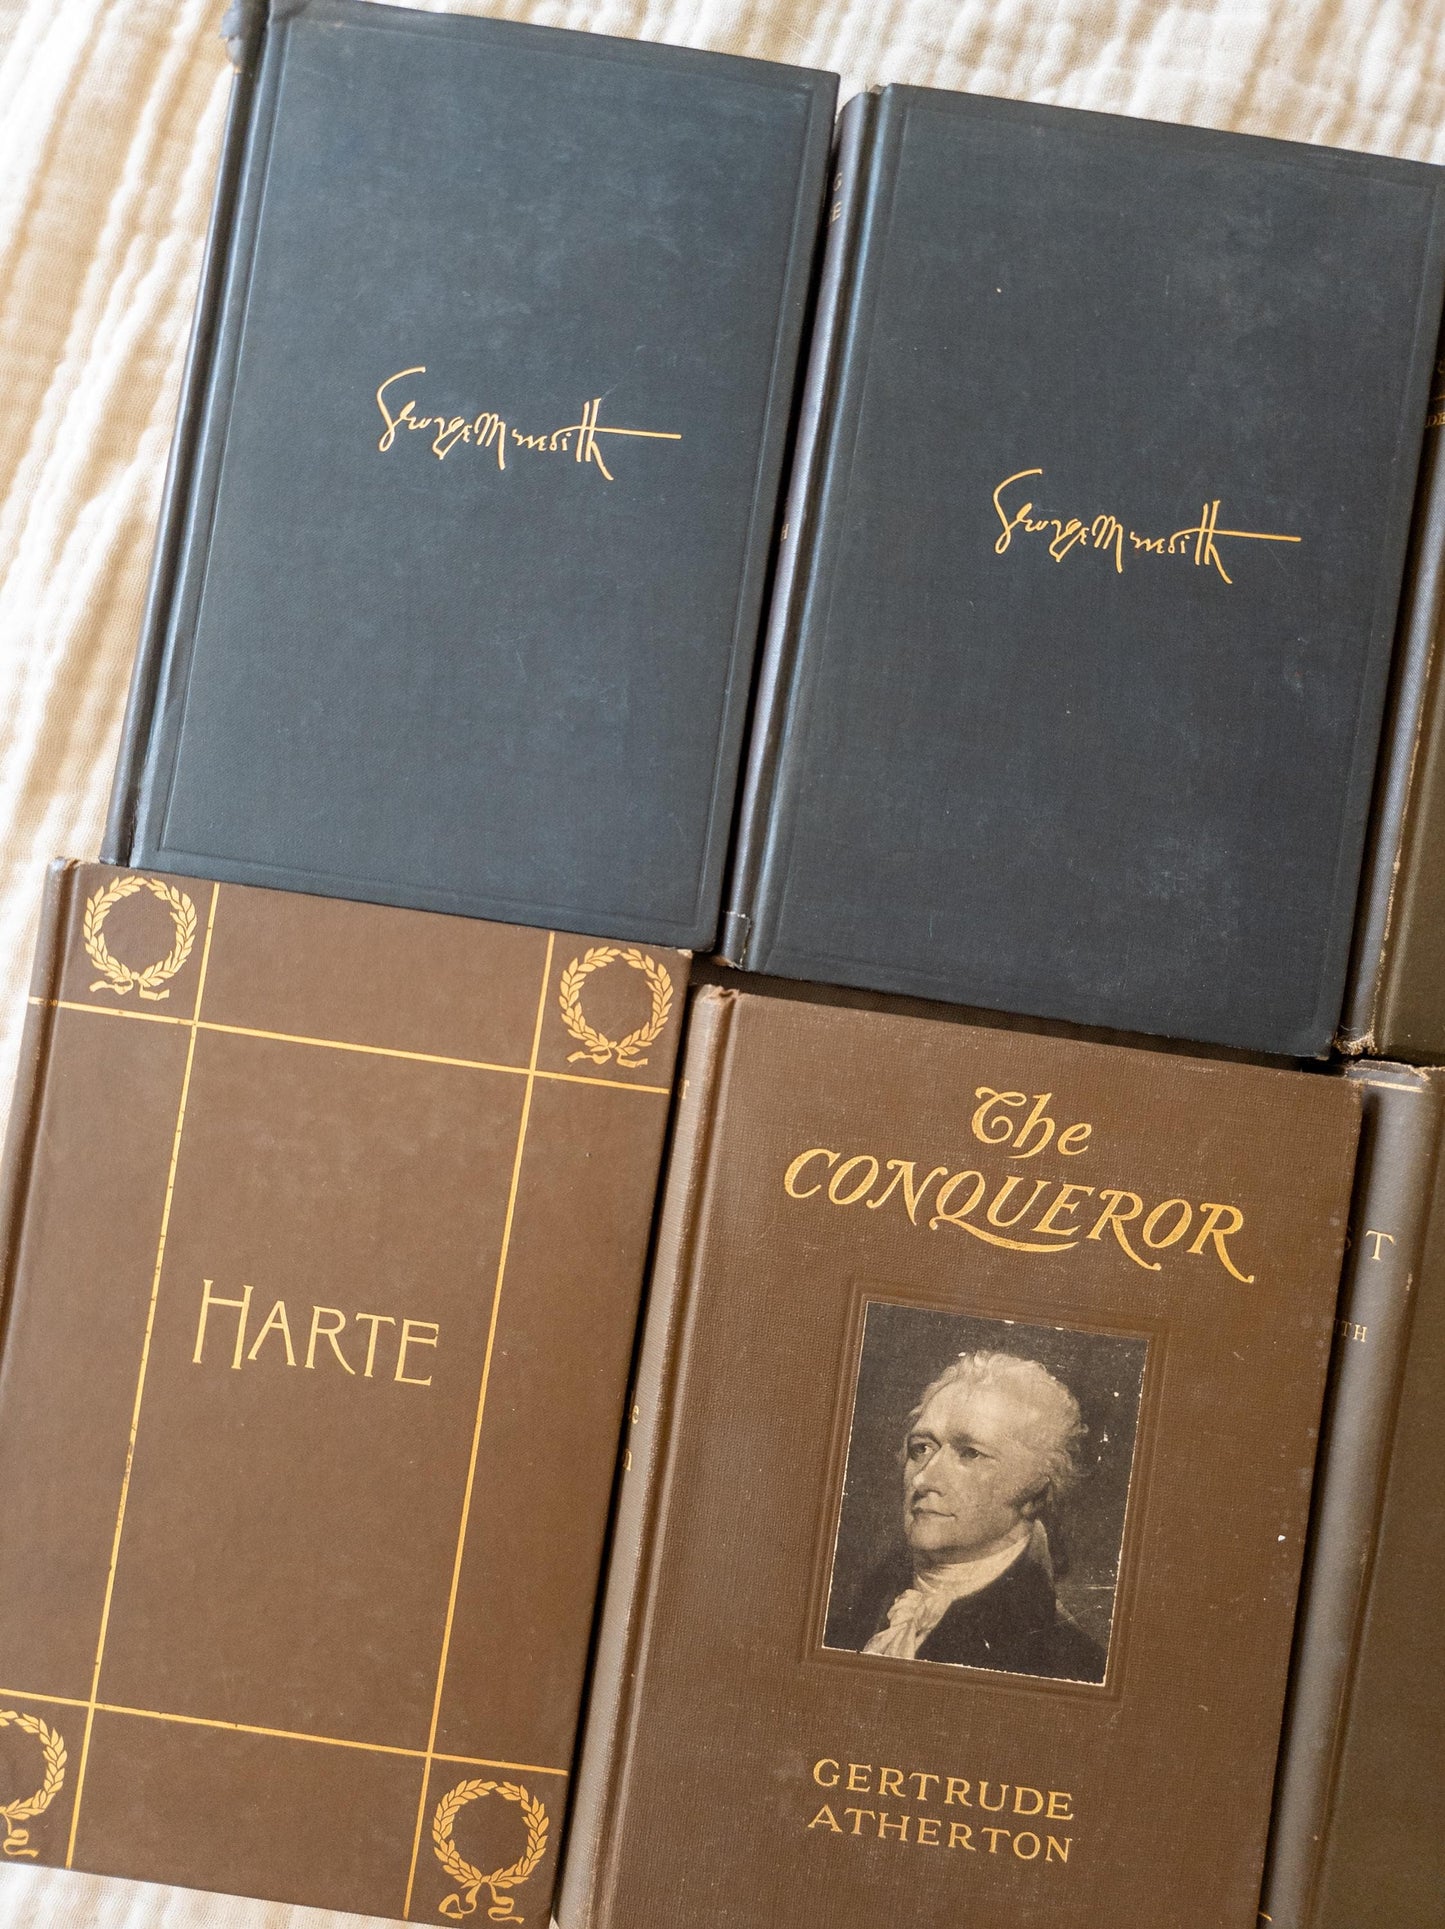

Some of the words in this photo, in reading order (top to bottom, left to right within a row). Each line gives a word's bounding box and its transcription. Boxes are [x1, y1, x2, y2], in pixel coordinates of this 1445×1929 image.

[971, 1086, 1092, 1159] The
[783, 1147, 1255, 1284] CONQUEROR
[192, 1278, 440, 1386] HARTE
[812, 1758, 1074, 1821] GERTRUDE
[807, 1803, 1073, 1864] ATHERTON
